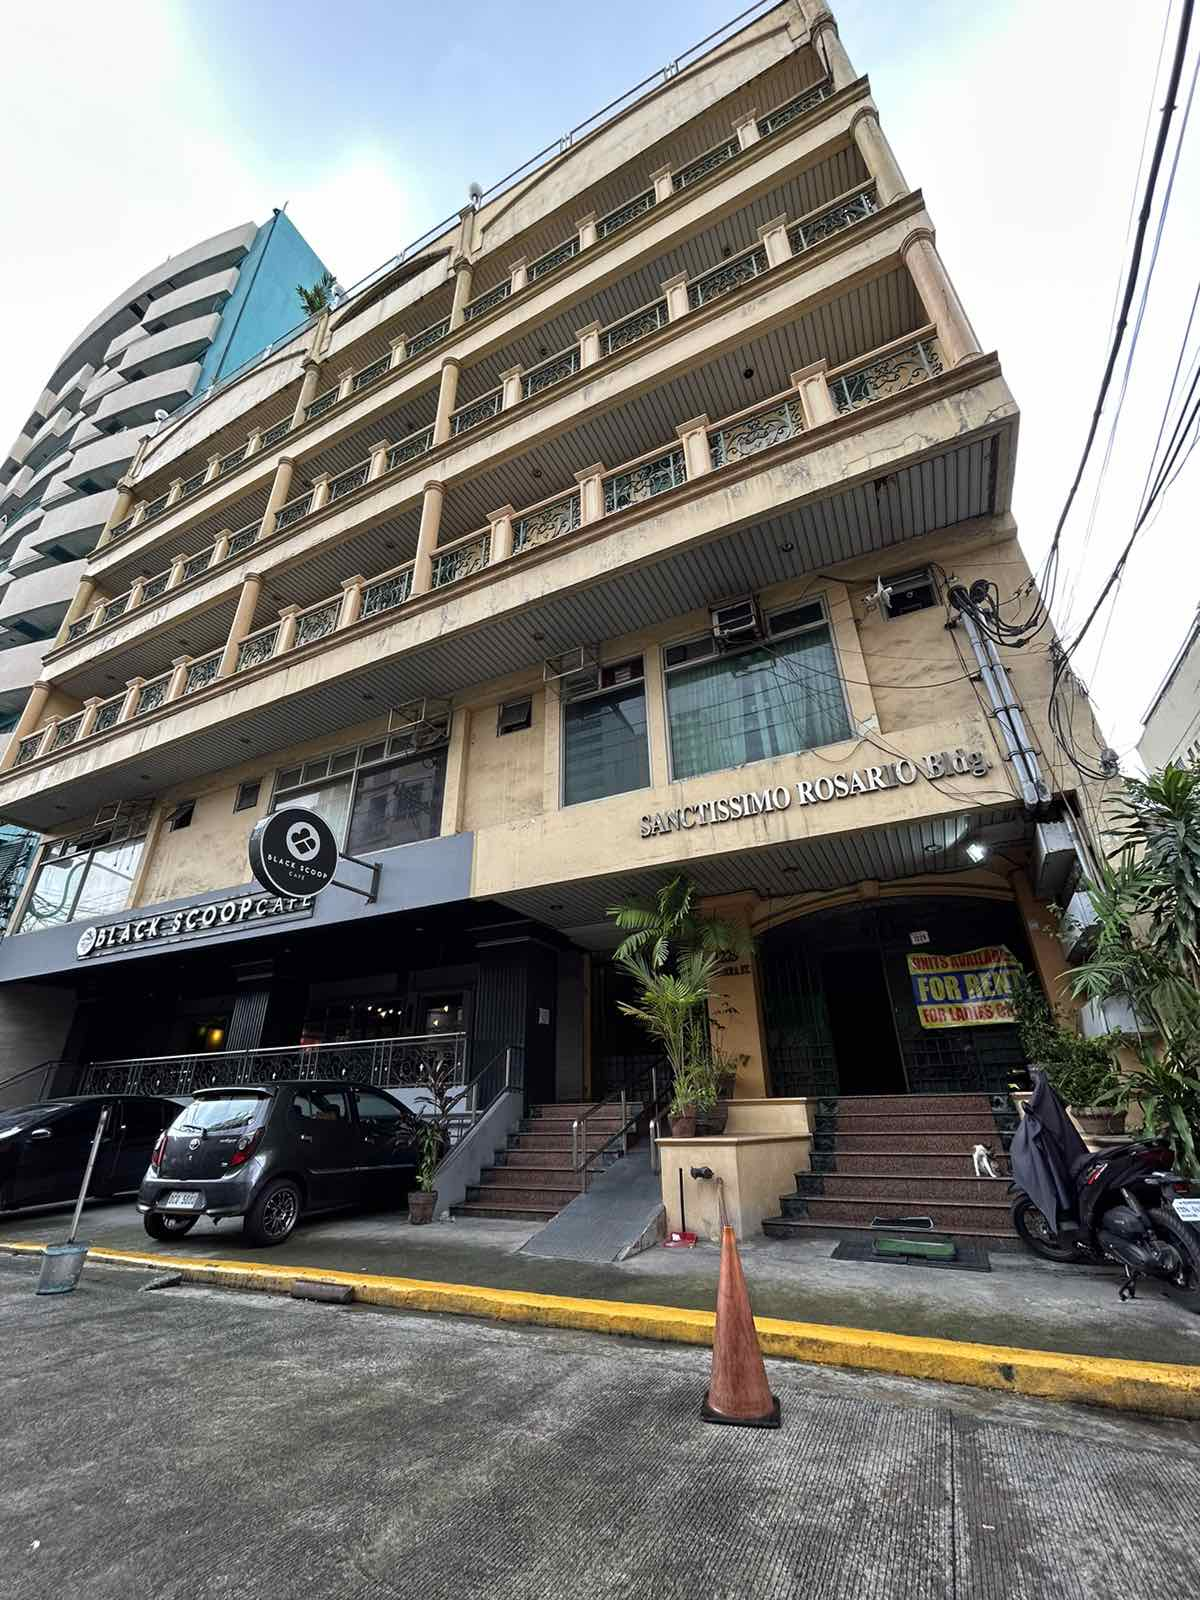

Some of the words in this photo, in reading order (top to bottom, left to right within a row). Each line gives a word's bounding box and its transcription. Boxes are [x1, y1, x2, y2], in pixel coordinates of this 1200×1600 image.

[641, 785, 791, 838] SANCTISSIMO
[796, 759, 917, 805] ROSARIO
[923, 749, 993, 781] Bldg.
[267, 854, 296, 868] BLACK
[300, 865, 328, 879] SCOOP
[96, 918, 161, 947] BLACK
[171, 899, 251, 932] SCOOP
[912, 955, 949, 971] UNITS
[918, 975, 962, 1001] FOR
[923, 1007, 945, 1023] FOR
[948, 1003, 993, 1021] LADIES
